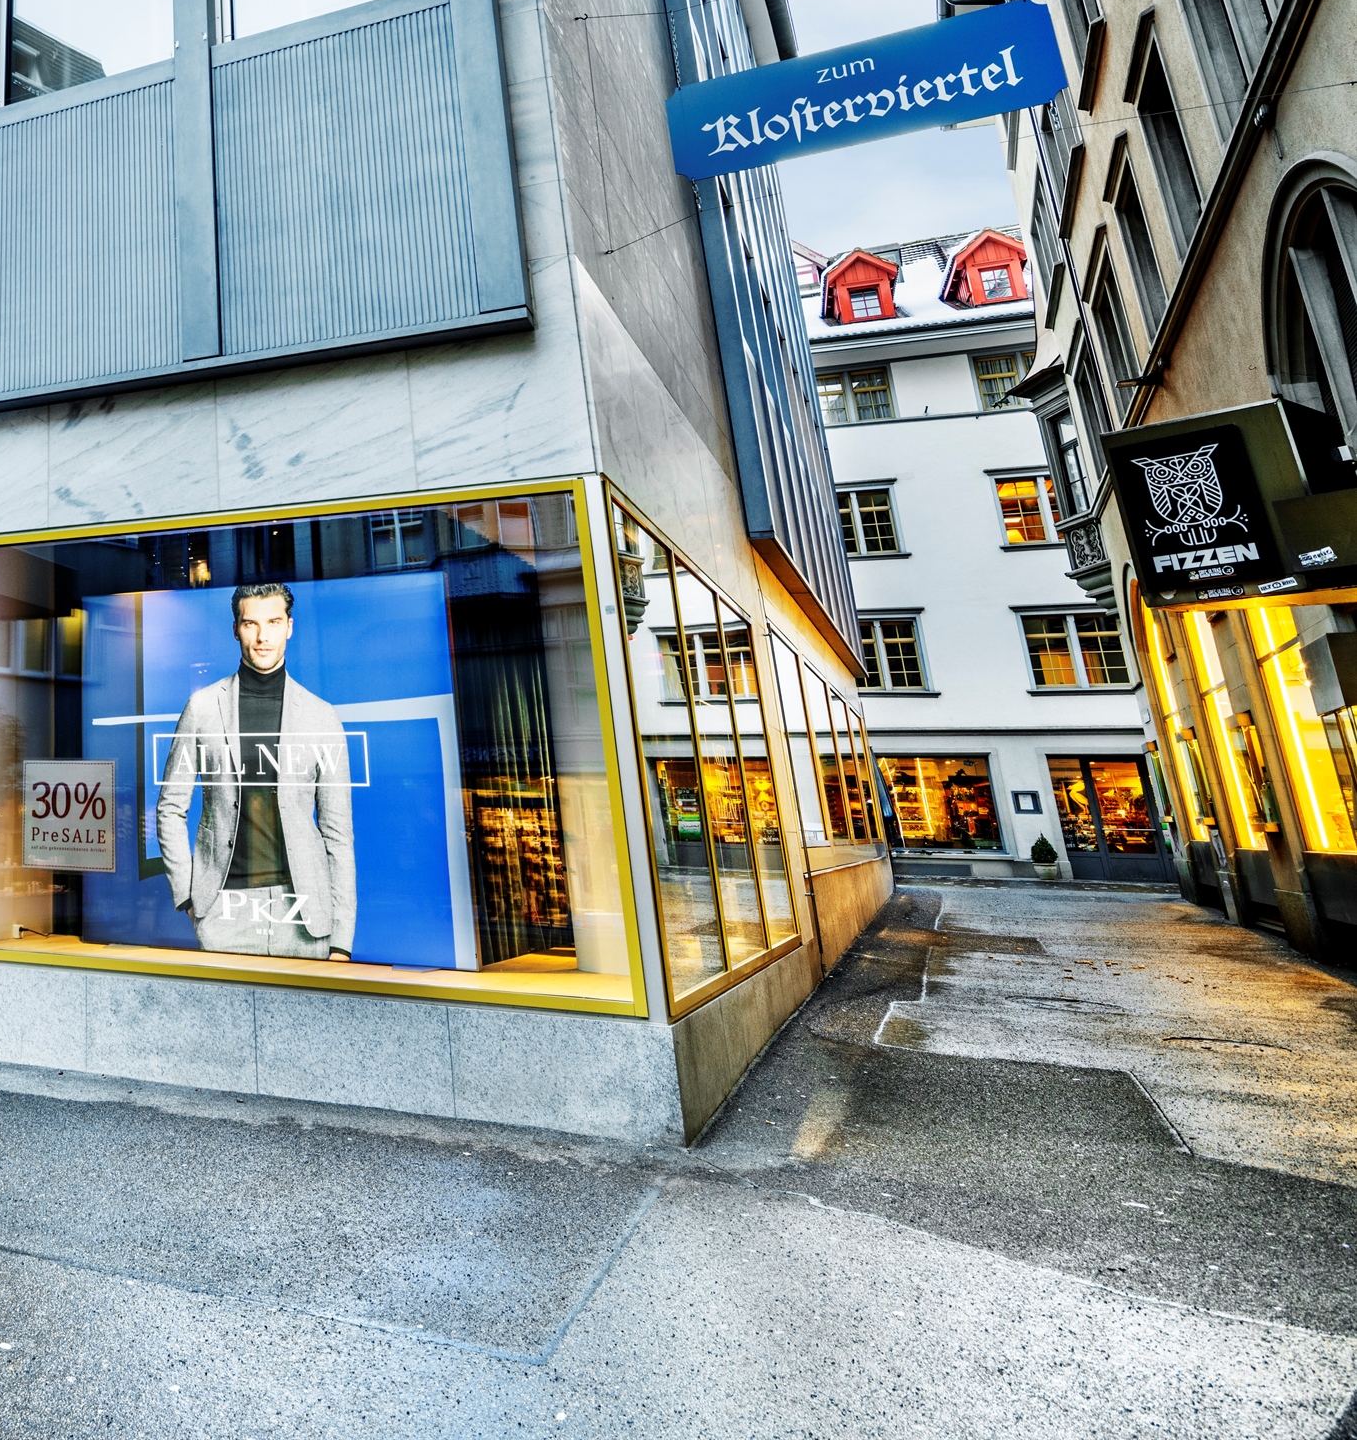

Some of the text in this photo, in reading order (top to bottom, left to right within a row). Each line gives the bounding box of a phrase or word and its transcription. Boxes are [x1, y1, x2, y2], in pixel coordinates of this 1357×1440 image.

[816, 57, 876, 84] zum
[1152, 542, 1260, 573] FIZZEN
[173, 743, 346, 776] ALL NEW
[31, 782, 107, 820] 30%
[31, 826, 107, 845] PreSALE
[218, 889, 311, 925] PKZ
[256, 928, 274, 936] MEN
